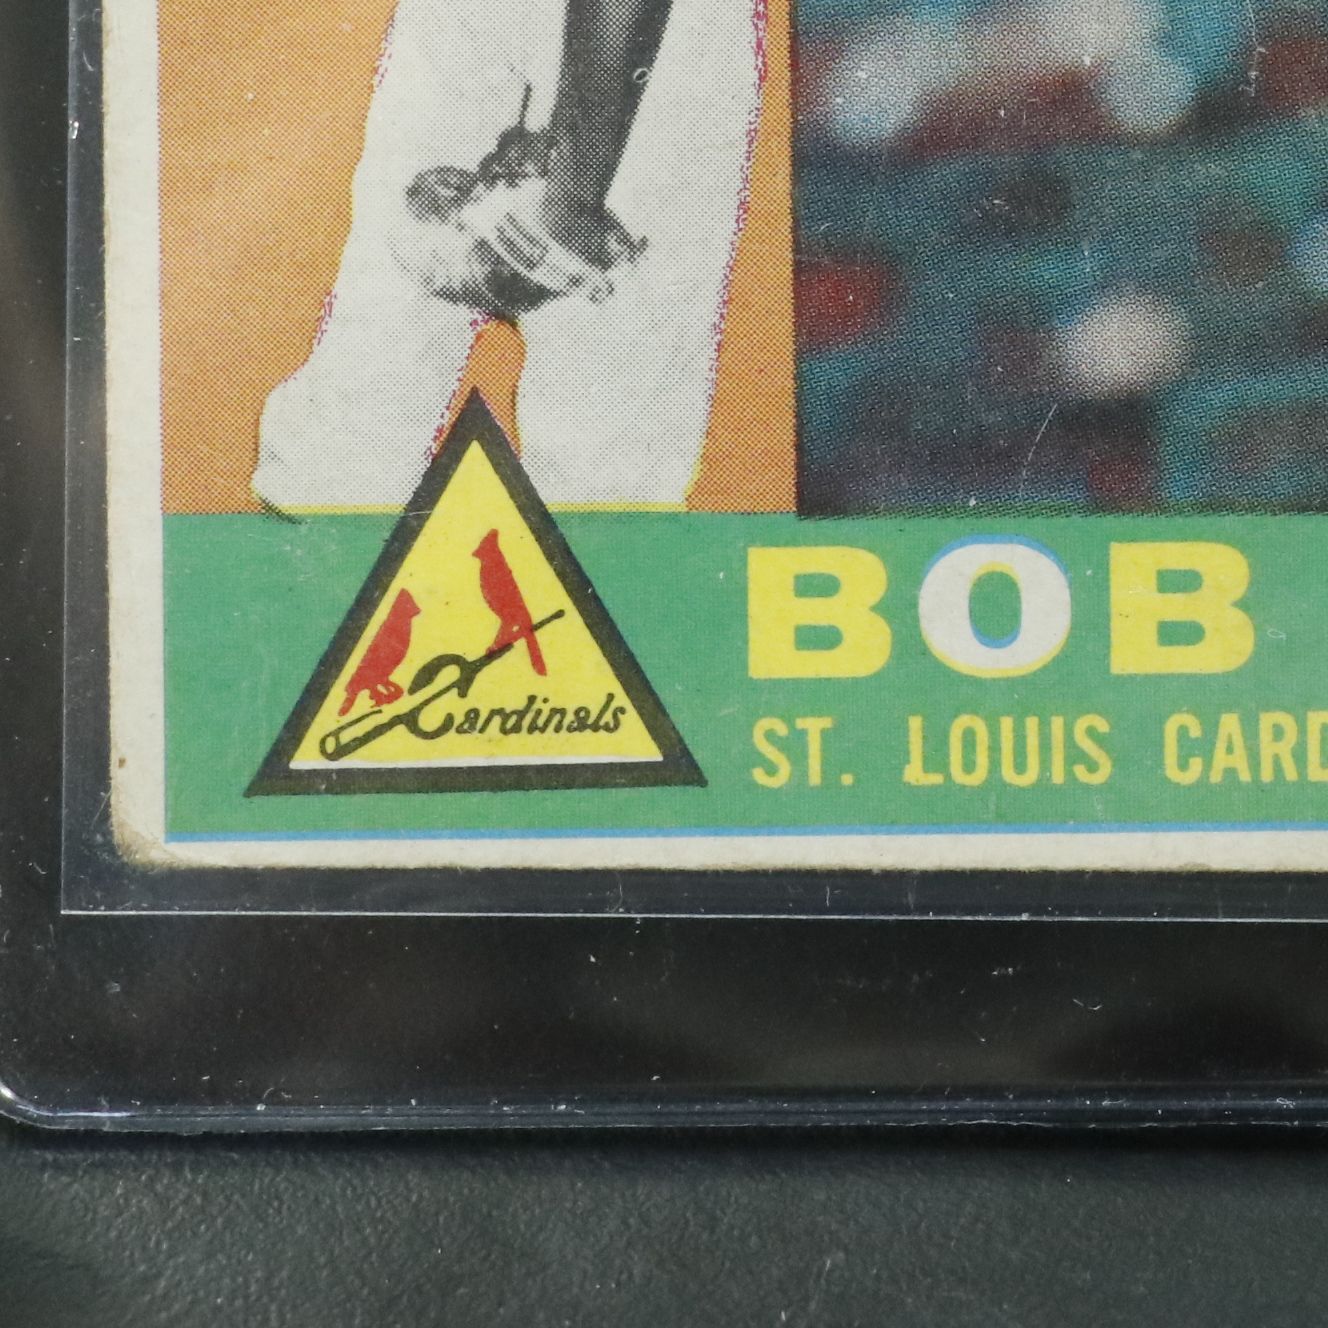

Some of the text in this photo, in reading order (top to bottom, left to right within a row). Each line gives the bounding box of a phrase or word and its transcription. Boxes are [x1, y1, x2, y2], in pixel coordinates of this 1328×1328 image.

[745, 533, 1257, 682] BOB
[405, 652, 627, 740] Cardinals
[750, 715, 855, 789] ST.
[902, 713, 1113, 788] LOUIS
